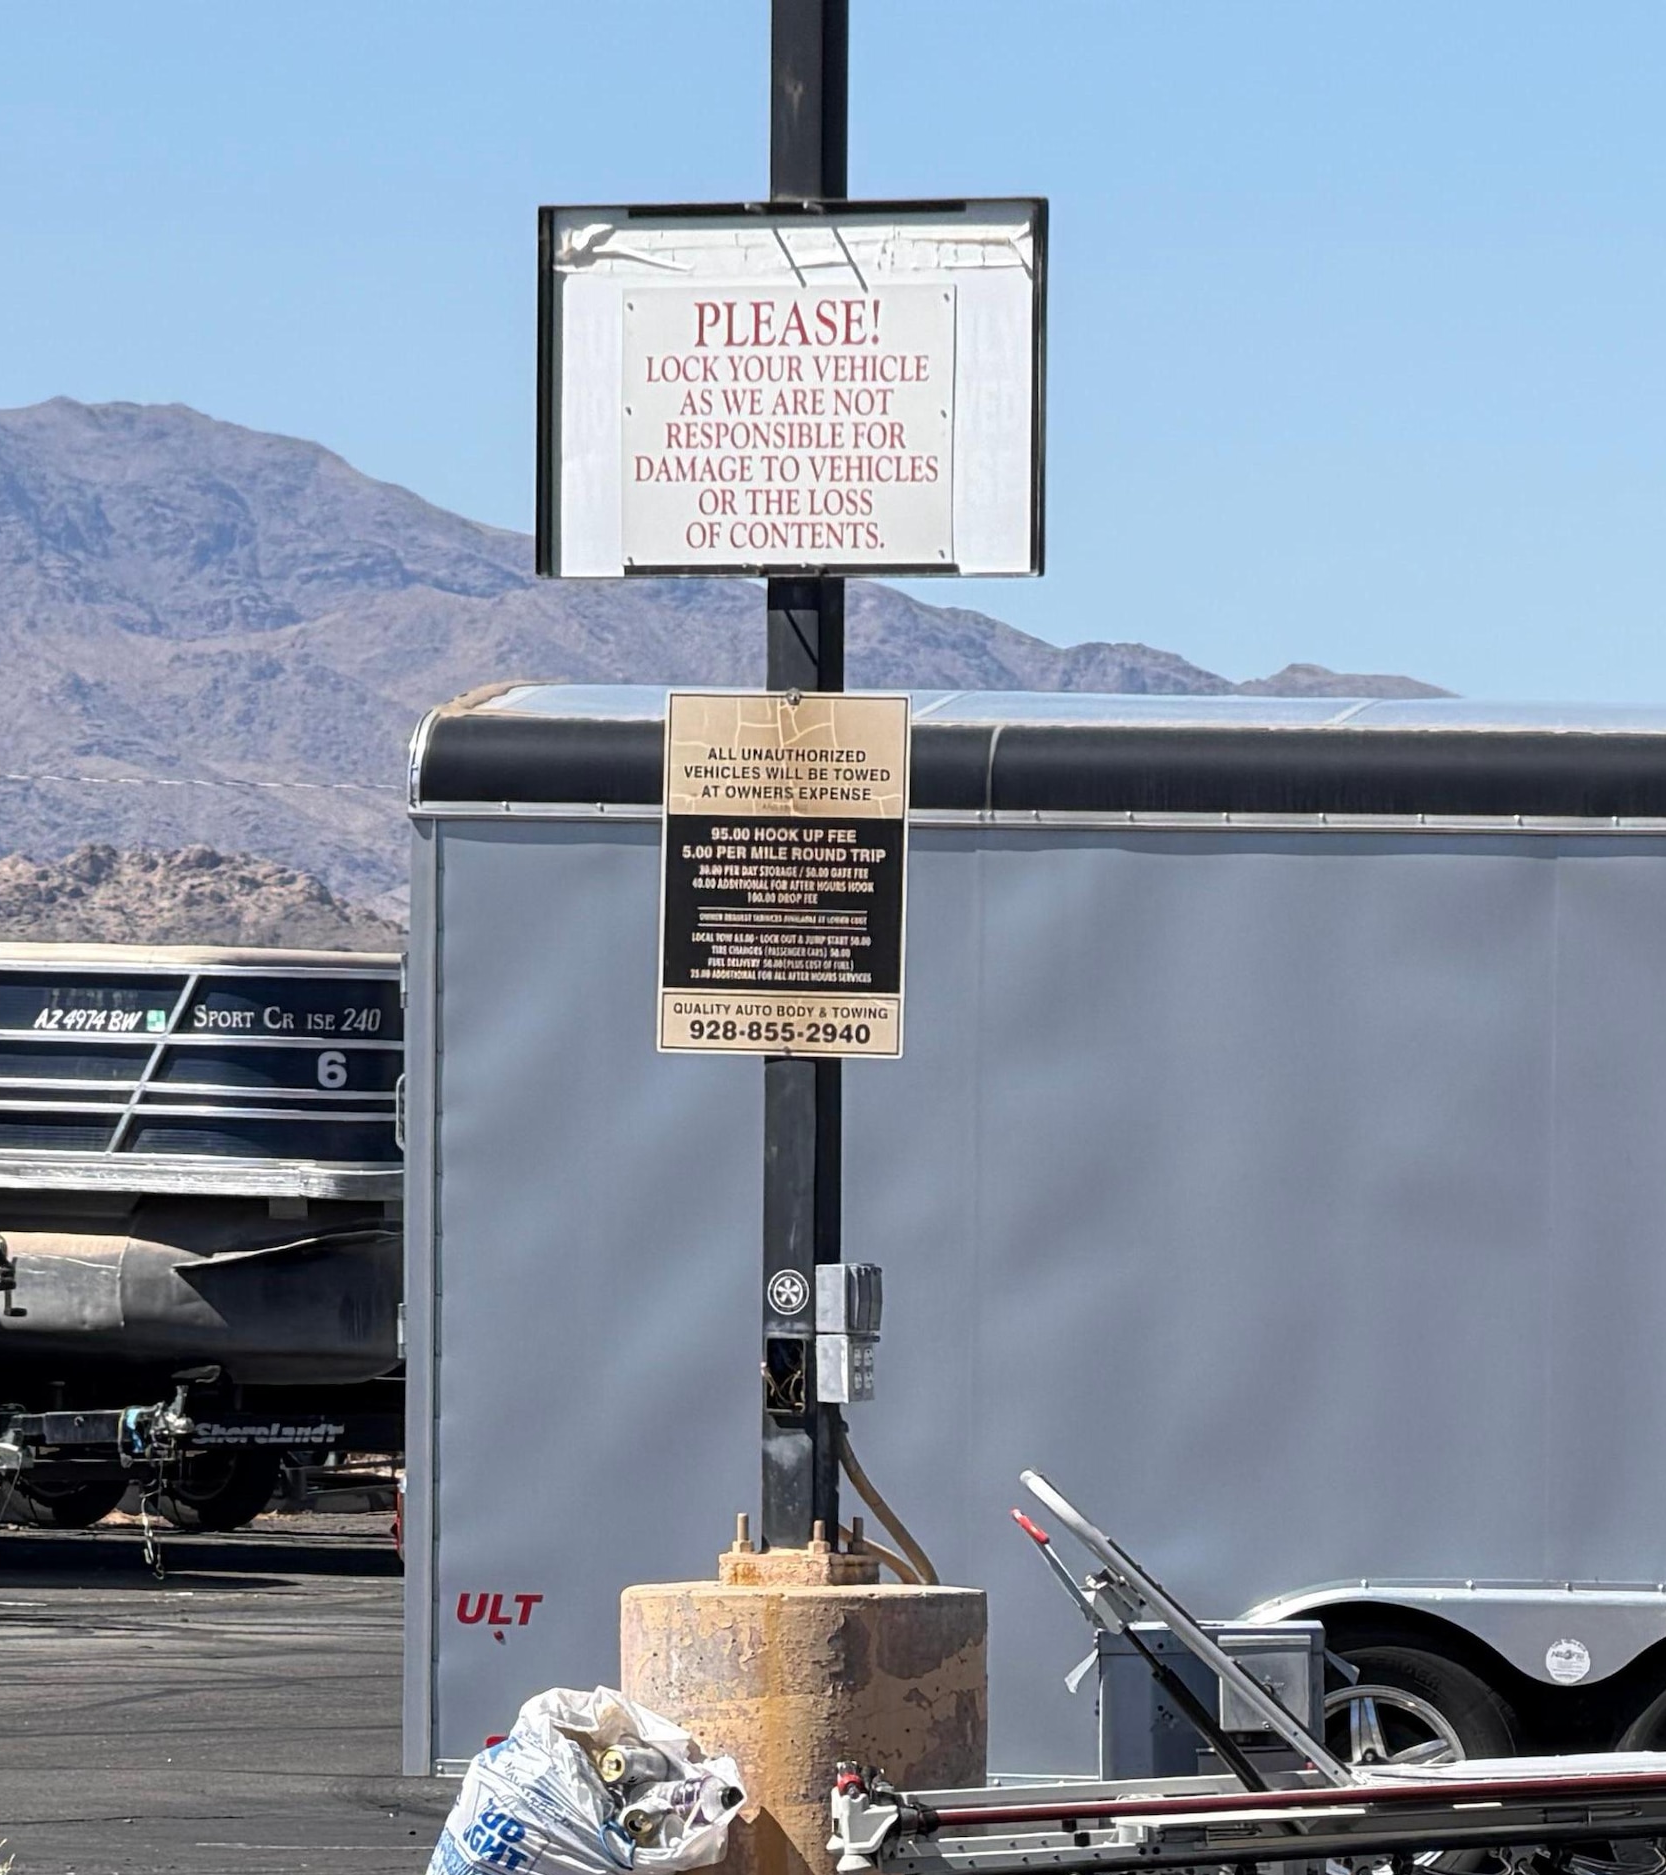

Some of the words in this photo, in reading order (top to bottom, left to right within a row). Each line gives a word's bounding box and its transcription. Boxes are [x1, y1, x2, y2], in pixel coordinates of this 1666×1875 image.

[694, 300, 881, 347] PLEASE!
[646, 356, 718, 383] LOCK
[729, 356, 804, 383] YOUR
[813, 355, 929, 383] VEHICLE
[680, 389, 713, 416] AS
[723, 389, 764, 416] WE
[771, 389, 824, 416] ARE
[833, 389, 895, 416] NOT
[665, 422, 844, 449] RESPONSIBLE
[853, 422, 907, 450] FOR
[634, 456, 752, 482] DAMAGE
[760, 456, 800, 482] TO
[810, 455, 939, 483] VEHICLES
[698, 489, 737, 516] OR
[744, 489, 801, 516] THE
[809, 489, 873, 516] LOSS
[686, 522, 722, 549] OF
[730, 522, 885, 549] CONTENTS.
[707, 747, 737, 761] ALL
[741, 748, 866, 763] UNAUTHORIZED
[684, 765, 761, 780] VEHICLES
[765, 766, 803, 780] WILL
[808, 768, 828, 781] BE
[833, 768, 891, 782] TOWED
[701, 784, 720, 798] AT
[725, 785, 794, 799] OWNERS
[799, 786, 872, 801] EXPENSE
[711, 827, 751, 841] 95.00
[754, 827, 799, 842] HOOK
[802, 829, 824, 843] UP
[827, 829, 857, 843] FEE
[682, 844, 713, 859] 5.00
[716, 845, 747, 859] PER
[750, 846, 788, 860] MILE
[791, 847, 847, 862] ROUND
[850, 848, 887, 863] TRIP
[724, 864, 740, 876] PER
[741, 865, 759, 877] DAY
[759, 865, 798, 878] STORAGE
[830, 867, 853, 879] GATE
[853, 867, 869, 880] FEE
[717, 877, 769, 891] ADDITIONAL
[770, 879, 788, 891] FOR
[789, 880, 815, 892] AFTER
[816, 880, 847, 892] HOURS
[847, 881, 874, 893] HOOK
[777, 892, 802, 904] DROP
[803, 893, 818, 905] FEE
[692, 932, 714, 942] LOCAL
[760, 933, 780, 944] LOCK
[788, 971, 810, 981] AFTER
[33, 1008, 64, 1029] AZ
[63, 1009, 107, 1031] 4974
[107, 1010, 143, 1032] BW
[193, 1004, 254, 1029] SPORT
[263, 1006, 336, 1031] CRISE
[340, 1008, 382, 1032] 240
[673, 1002, 731, 1016] QUALITY
[736, 1004, 771, 1017] AUTO
[776, 1005, 813, 1018] BODY
[818, 1006, 827, 1018] &
[832, 1007, 889, 1020] TOWING
[689, 1020, 871, 1044] 928-855-2940
[316, 1051, 348, 1089] 6
[457, 1593, 544, 1625] ULT
[480, 1800, 526, 1843] UD
